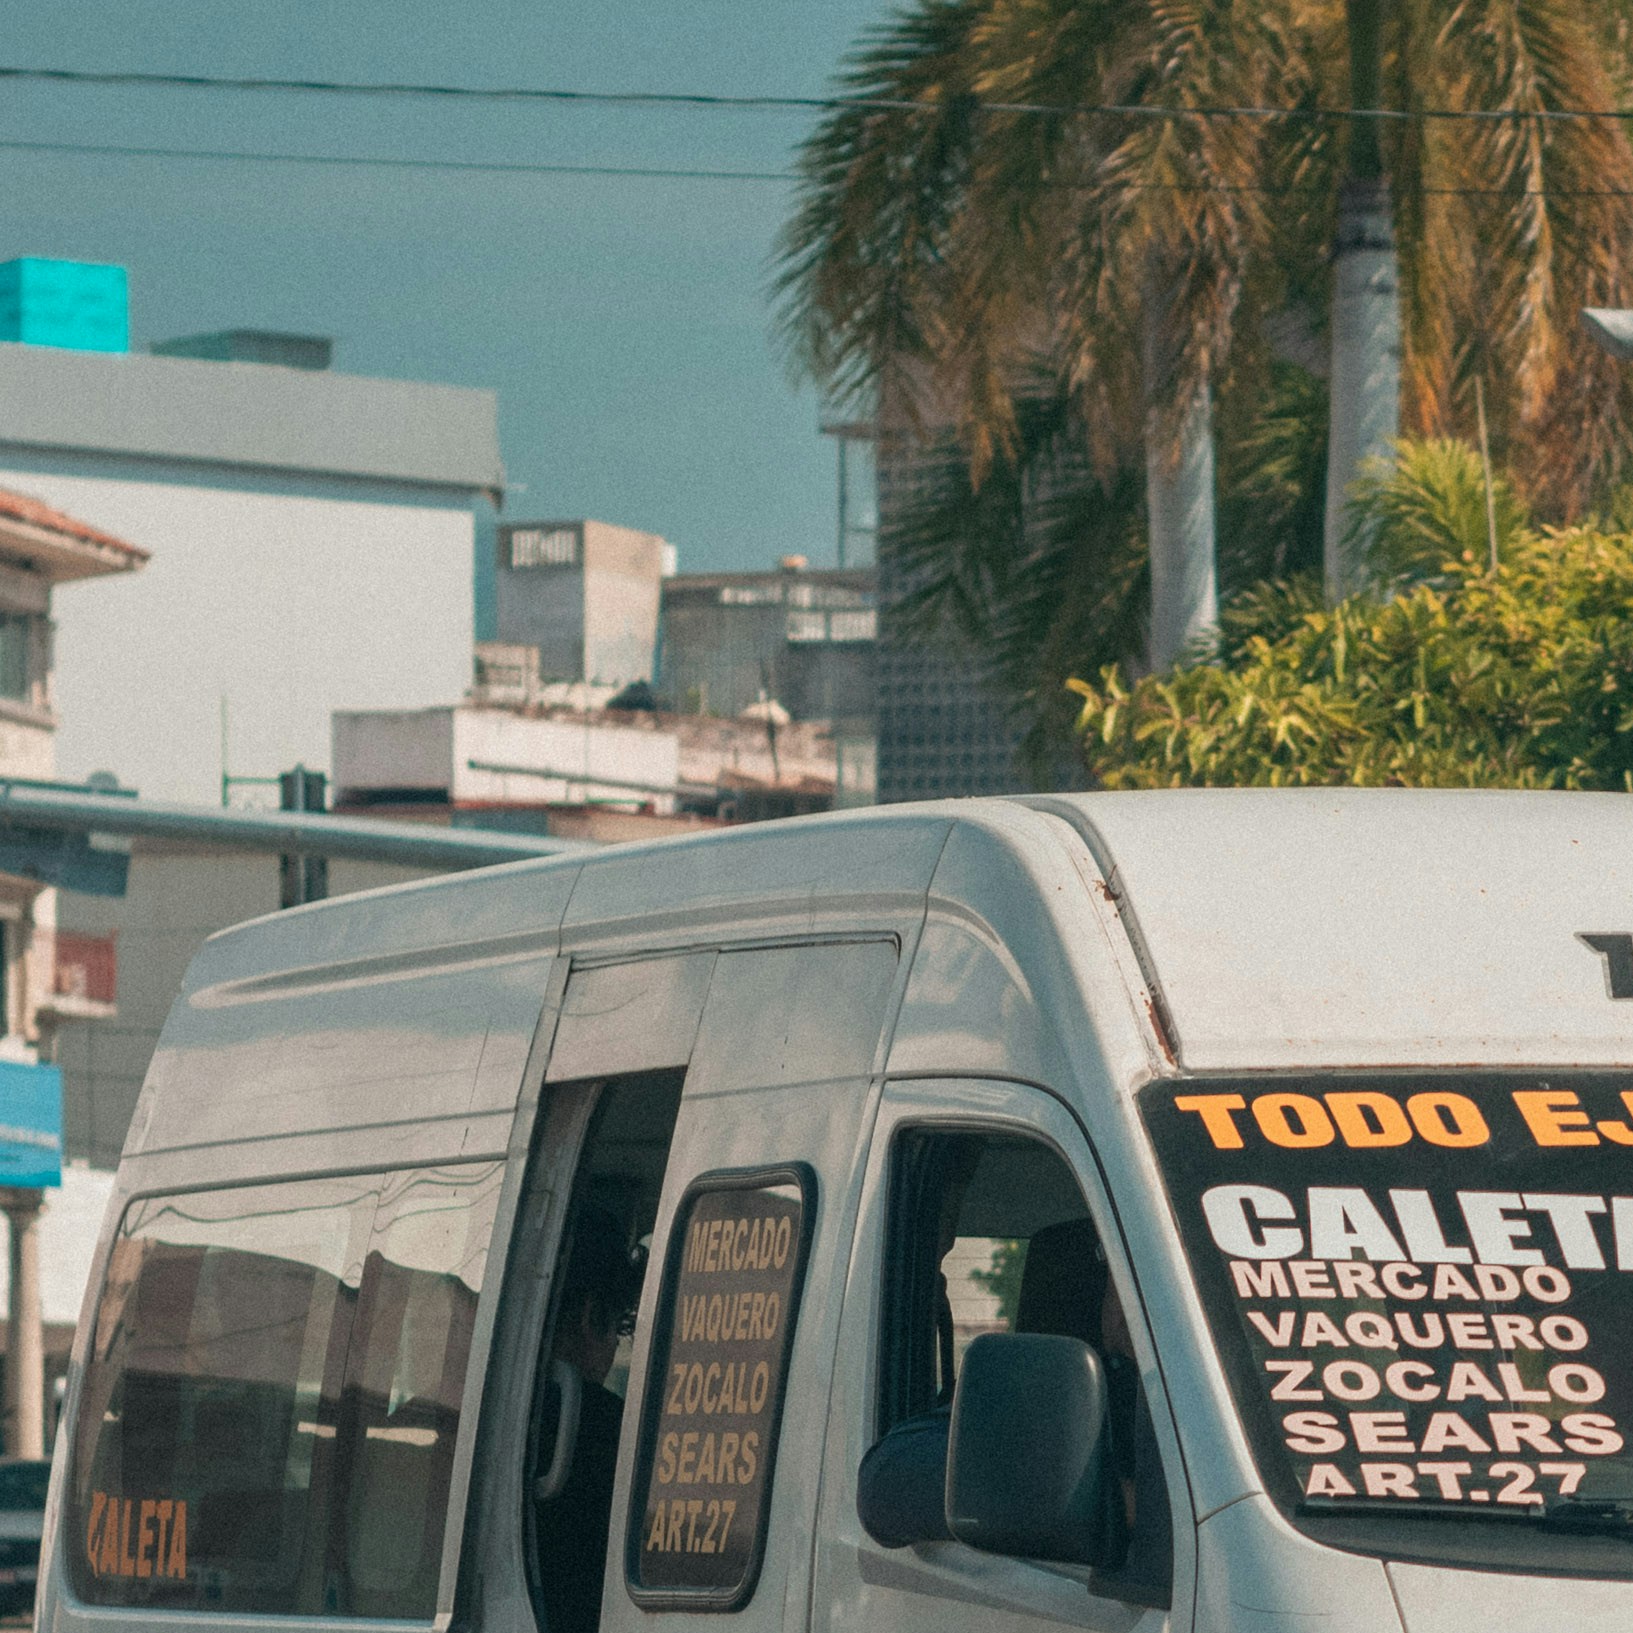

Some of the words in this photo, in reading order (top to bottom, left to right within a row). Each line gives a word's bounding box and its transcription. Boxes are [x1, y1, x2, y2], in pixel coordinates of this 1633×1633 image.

[1175, 1091, 1490, 1149] TODO
[688, 1216, 791, 1273] MERCADO
[1230, 1260, 1571, 1303] MERCADO
[681, 1291, 780, 1343] VAQUERO
[1247, 1311, 1589, 1351] VAQUERO
[667, 1361, 769, 1415] ZOCALO
[1265, 1361, 1606, 1402] ZOCALO
[658, 1431, 759, 1485] SEARS
[1283, 1411, 1625, 1454] SEARS
[1306, 1461, 1586, 1504] ART.27
[646, 1499, 737, 1553] ART.27
